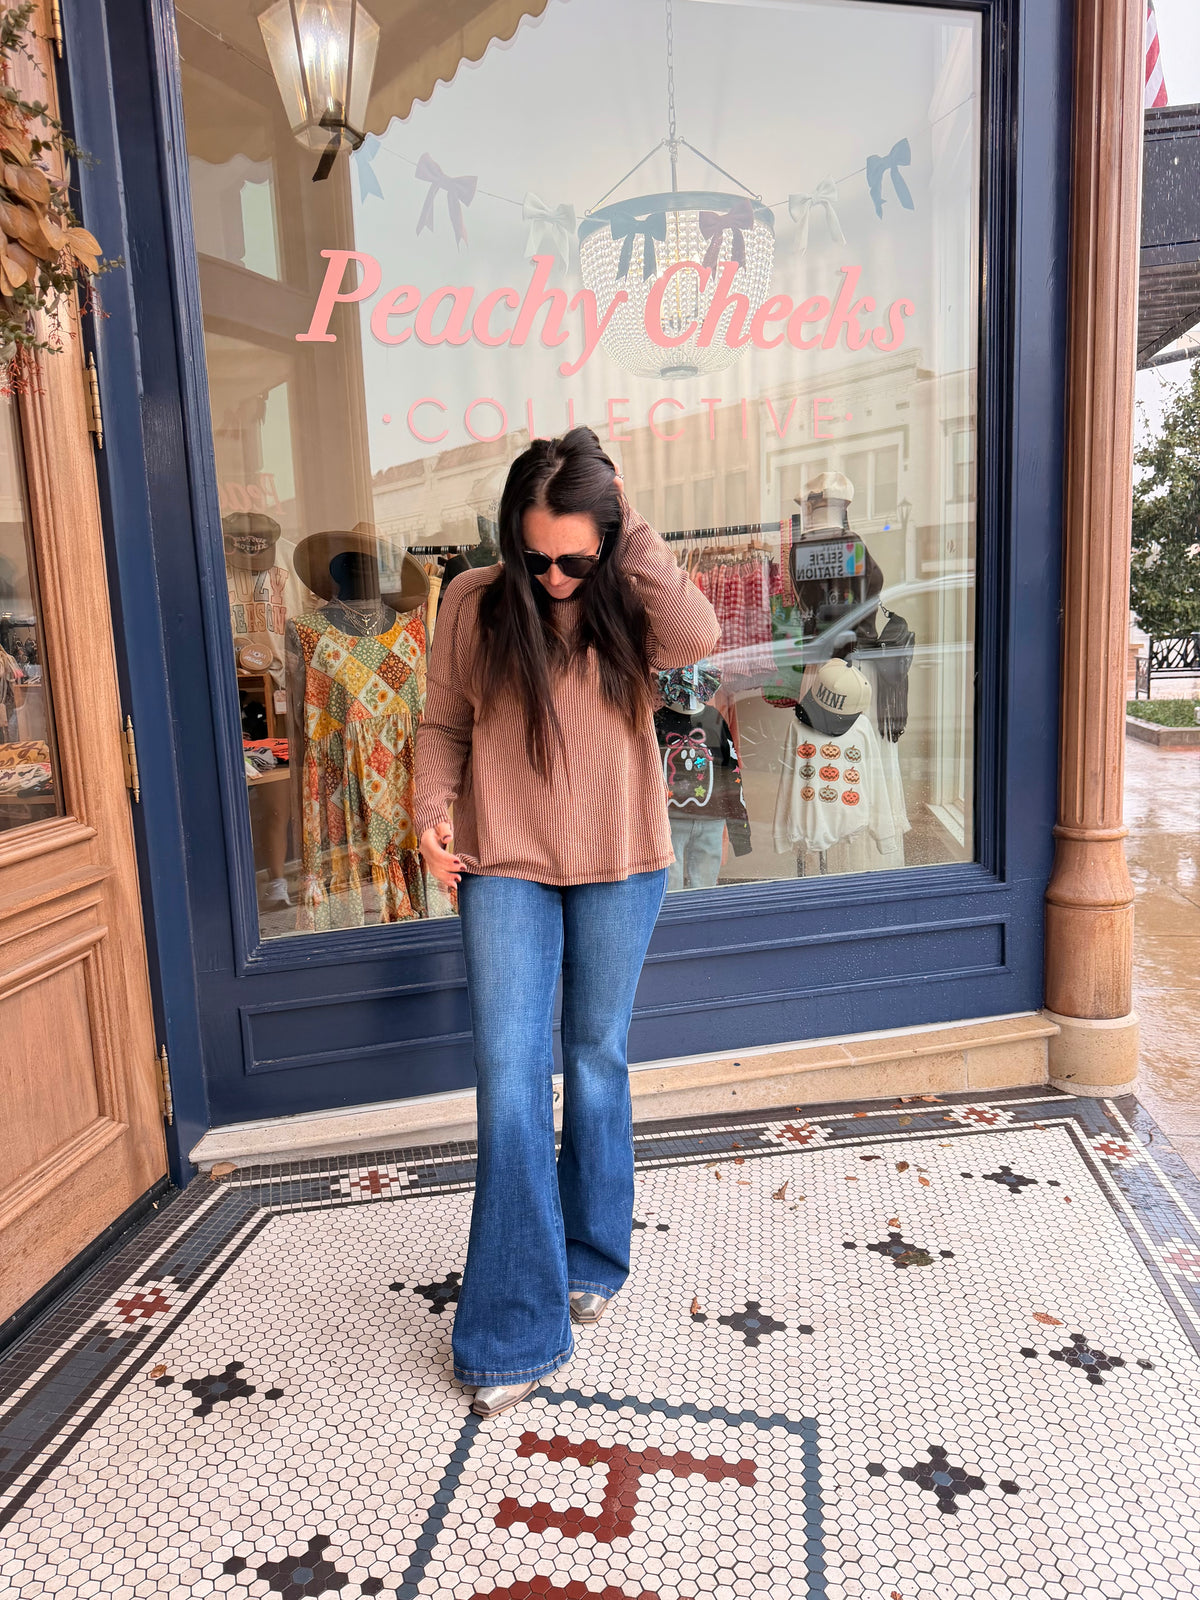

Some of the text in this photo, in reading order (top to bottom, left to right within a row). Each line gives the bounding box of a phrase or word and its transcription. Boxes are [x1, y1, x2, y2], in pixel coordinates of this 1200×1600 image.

[296, 250, 914, 375] Peachy Cheeks
[225, 565, 289, 605] OZY
[230, 602, 287, 635] EASON
[816, 681, 848, 711] MINI
